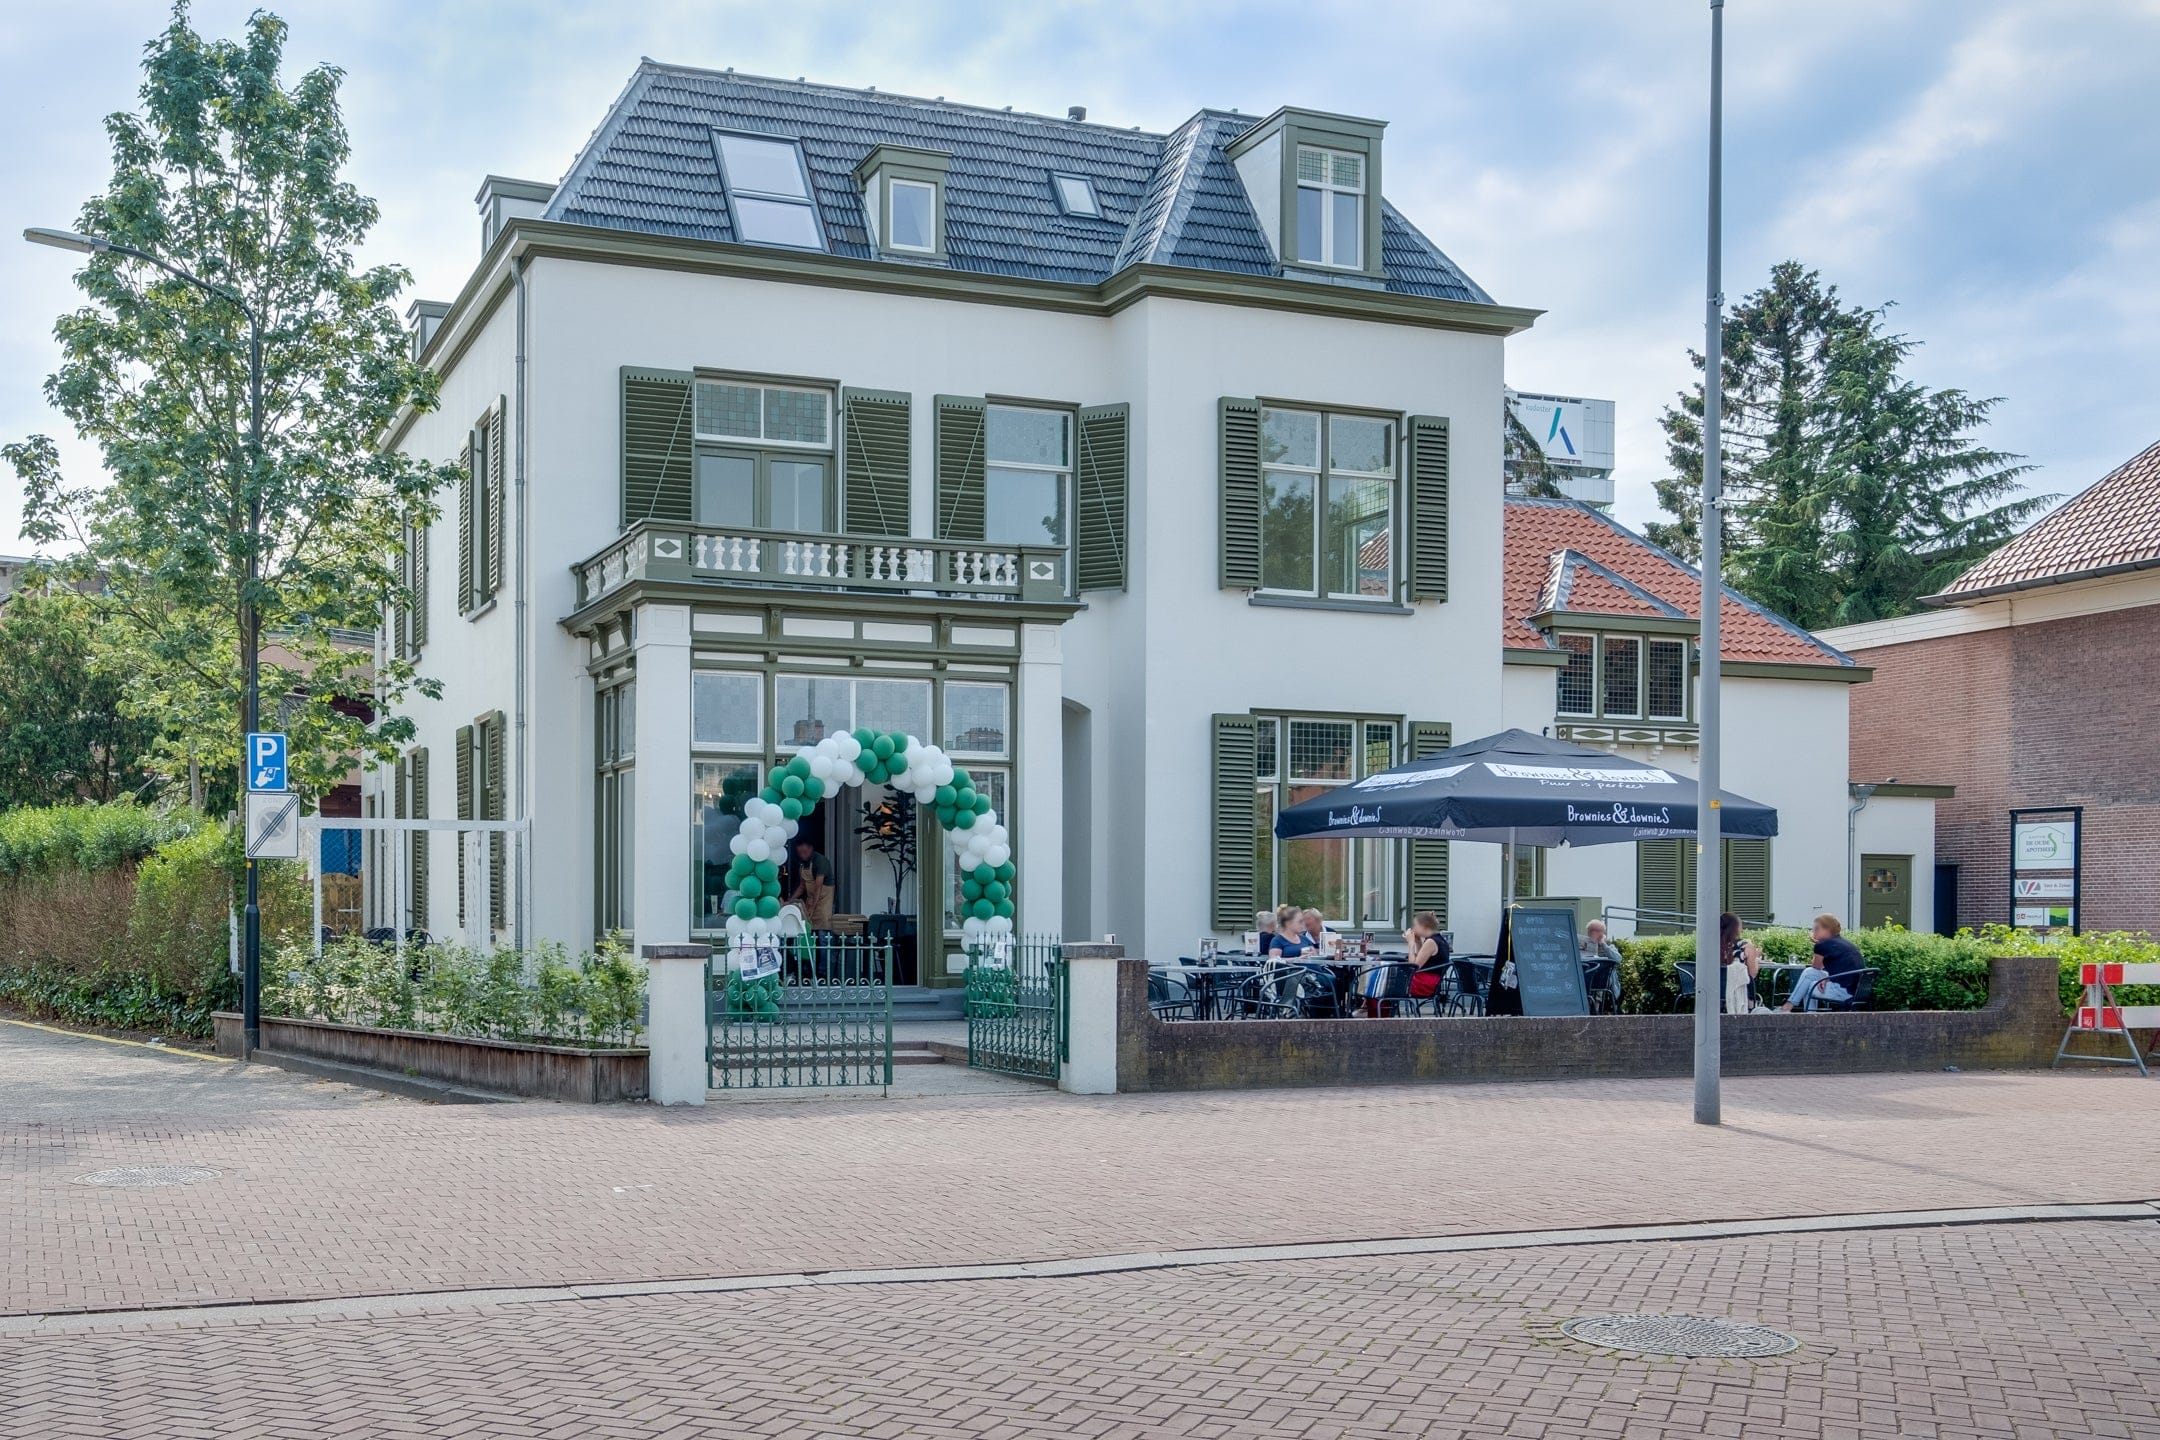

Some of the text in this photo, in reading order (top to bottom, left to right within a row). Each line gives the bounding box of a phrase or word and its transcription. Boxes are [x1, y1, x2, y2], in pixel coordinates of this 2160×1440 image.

[256, 737, 278, 766] P
[1597, 781, 1647, 790] perfect
[1567, 804, 1611, 822] Brownies
